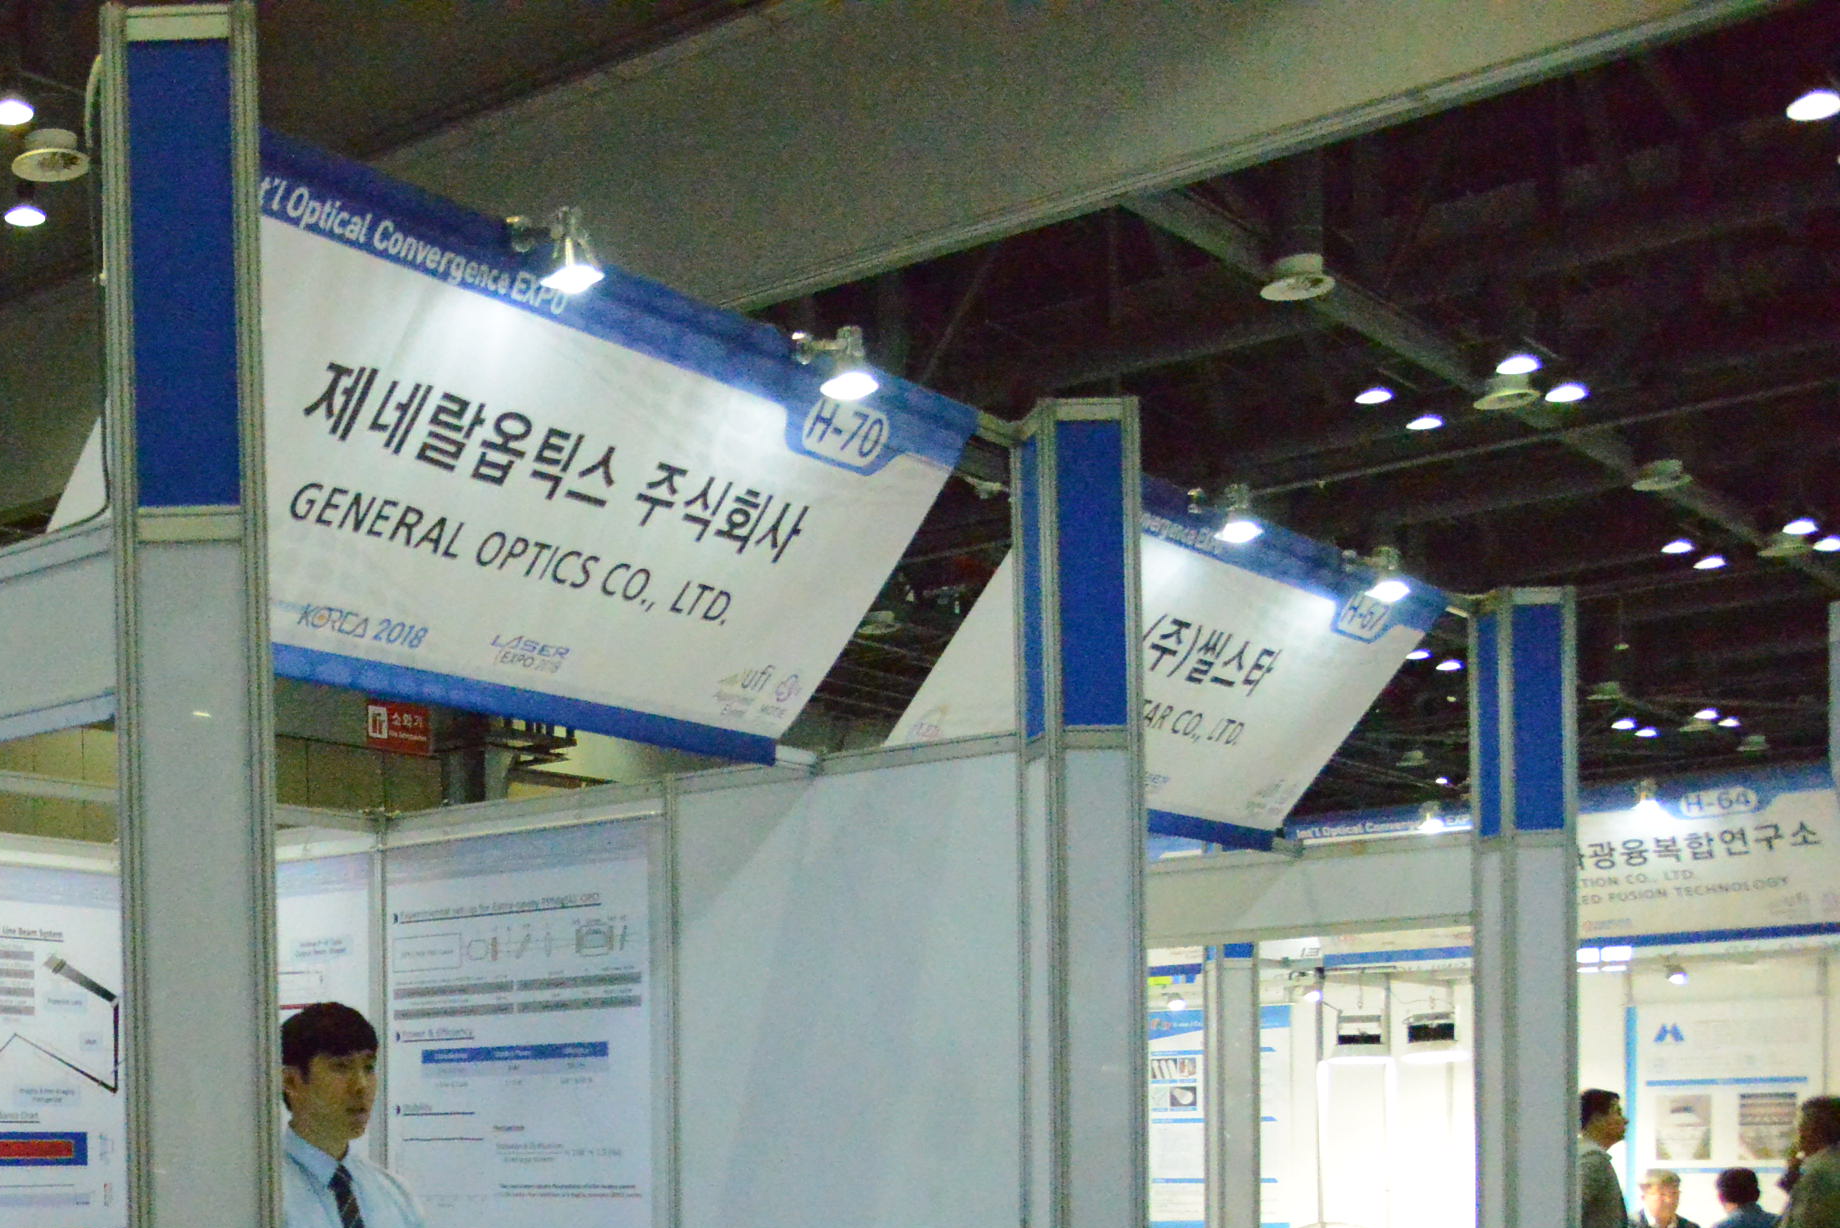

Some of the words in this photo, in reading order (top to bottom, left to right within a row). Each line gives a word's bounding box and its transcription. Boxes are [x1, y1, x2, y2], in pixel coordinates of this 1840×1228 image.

[286, 186, 374, 244] Optical
[372, 219, 509, 294] Convergence
[510, 270, 569, 316] EXPO
[303, 361, 617, 509] 제네랄옵틱스
[635, 461, 810, 564] 주식회사
[806, 400, 886, 460] H-70
[289, 480, 476, 559] GENERAL
[474, 530, 601, 590] OPTICS
[670, 579, 732, 627] LTD.
[297, 603, 369, 639] KOREA
[372, 618, 429, 650] 2018
[490, 634, 572, 659] LASER
